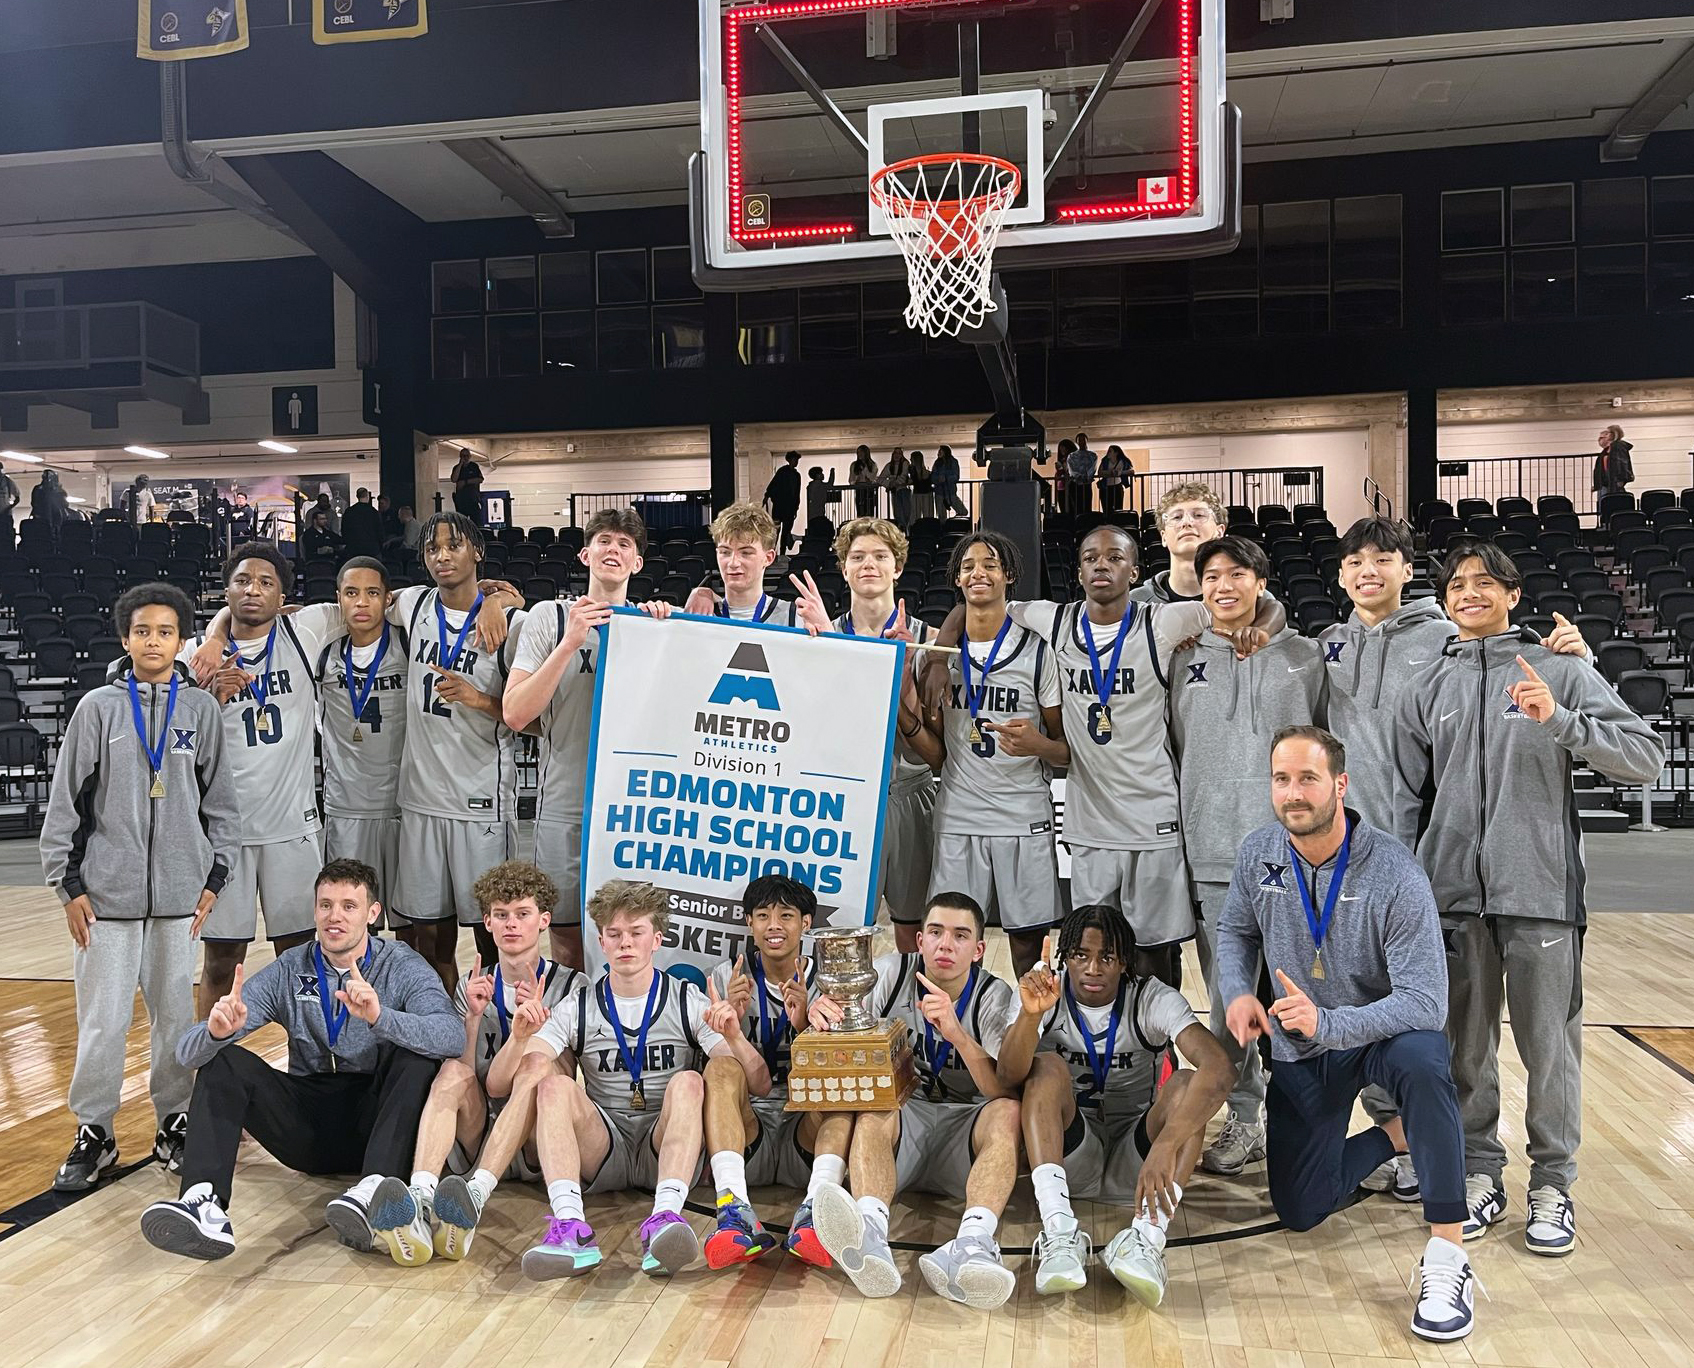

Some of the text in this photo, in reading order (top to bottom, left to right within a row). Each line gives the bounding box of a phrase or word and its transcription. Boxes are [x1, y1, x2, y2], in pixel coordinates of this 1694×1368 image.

[333, 15, 355, 25] CEBL
[159, 33, 180, 43] CEBL
[747, 217, 766, 226] CEBL
[153, 486, 171, 495] SEAT
[241, 703, 284, 748] 10
[359, 696, 383, 734] 4
[694, 711, 791, 744] METRO
[703, 737, 778, 754] ATHLETICS
[694, 751, 782, 777] Division 1
[626, 769, 846, 822] EDMONTON
[605, 804, 859, 861] HIGH SCHOOL
[612, 840, 843, 895] CHAMPIONS
[668, 894, 728, 918] Senior
